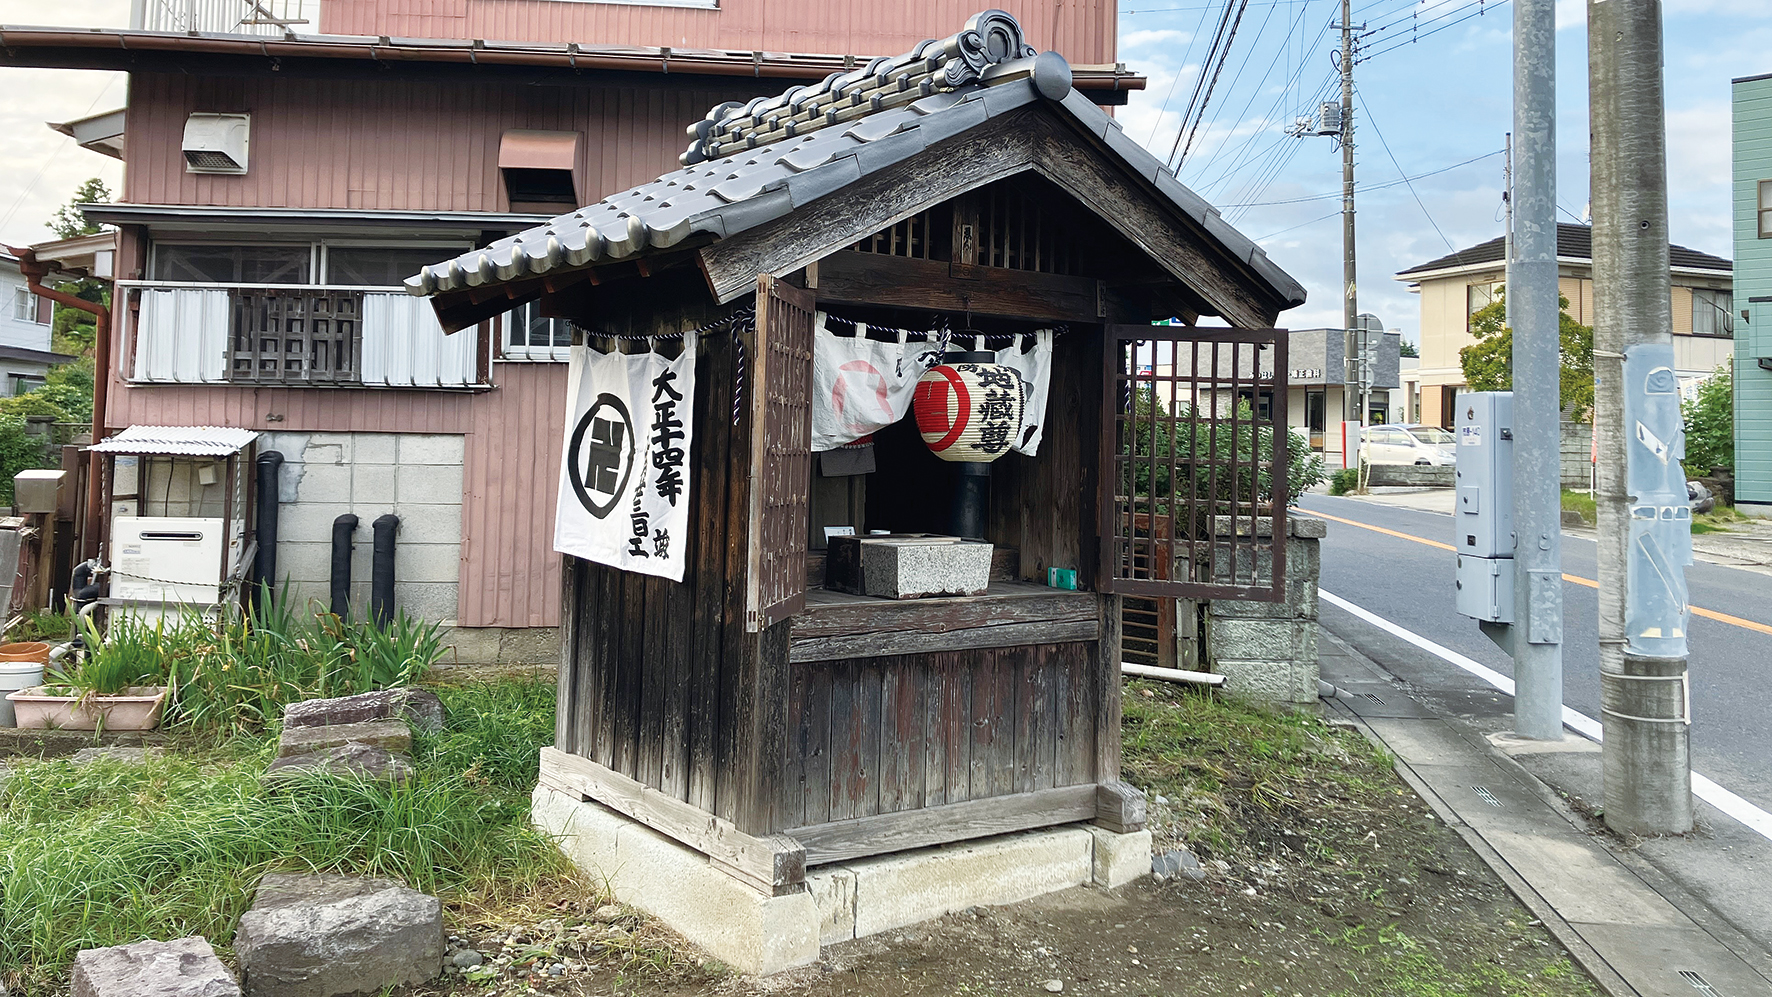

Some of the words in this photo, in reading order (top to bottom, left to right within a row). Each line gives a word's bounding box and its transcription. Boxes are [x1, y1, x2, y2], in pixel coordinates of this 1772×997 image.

[651, 366, 685, 508] 大正十四年
